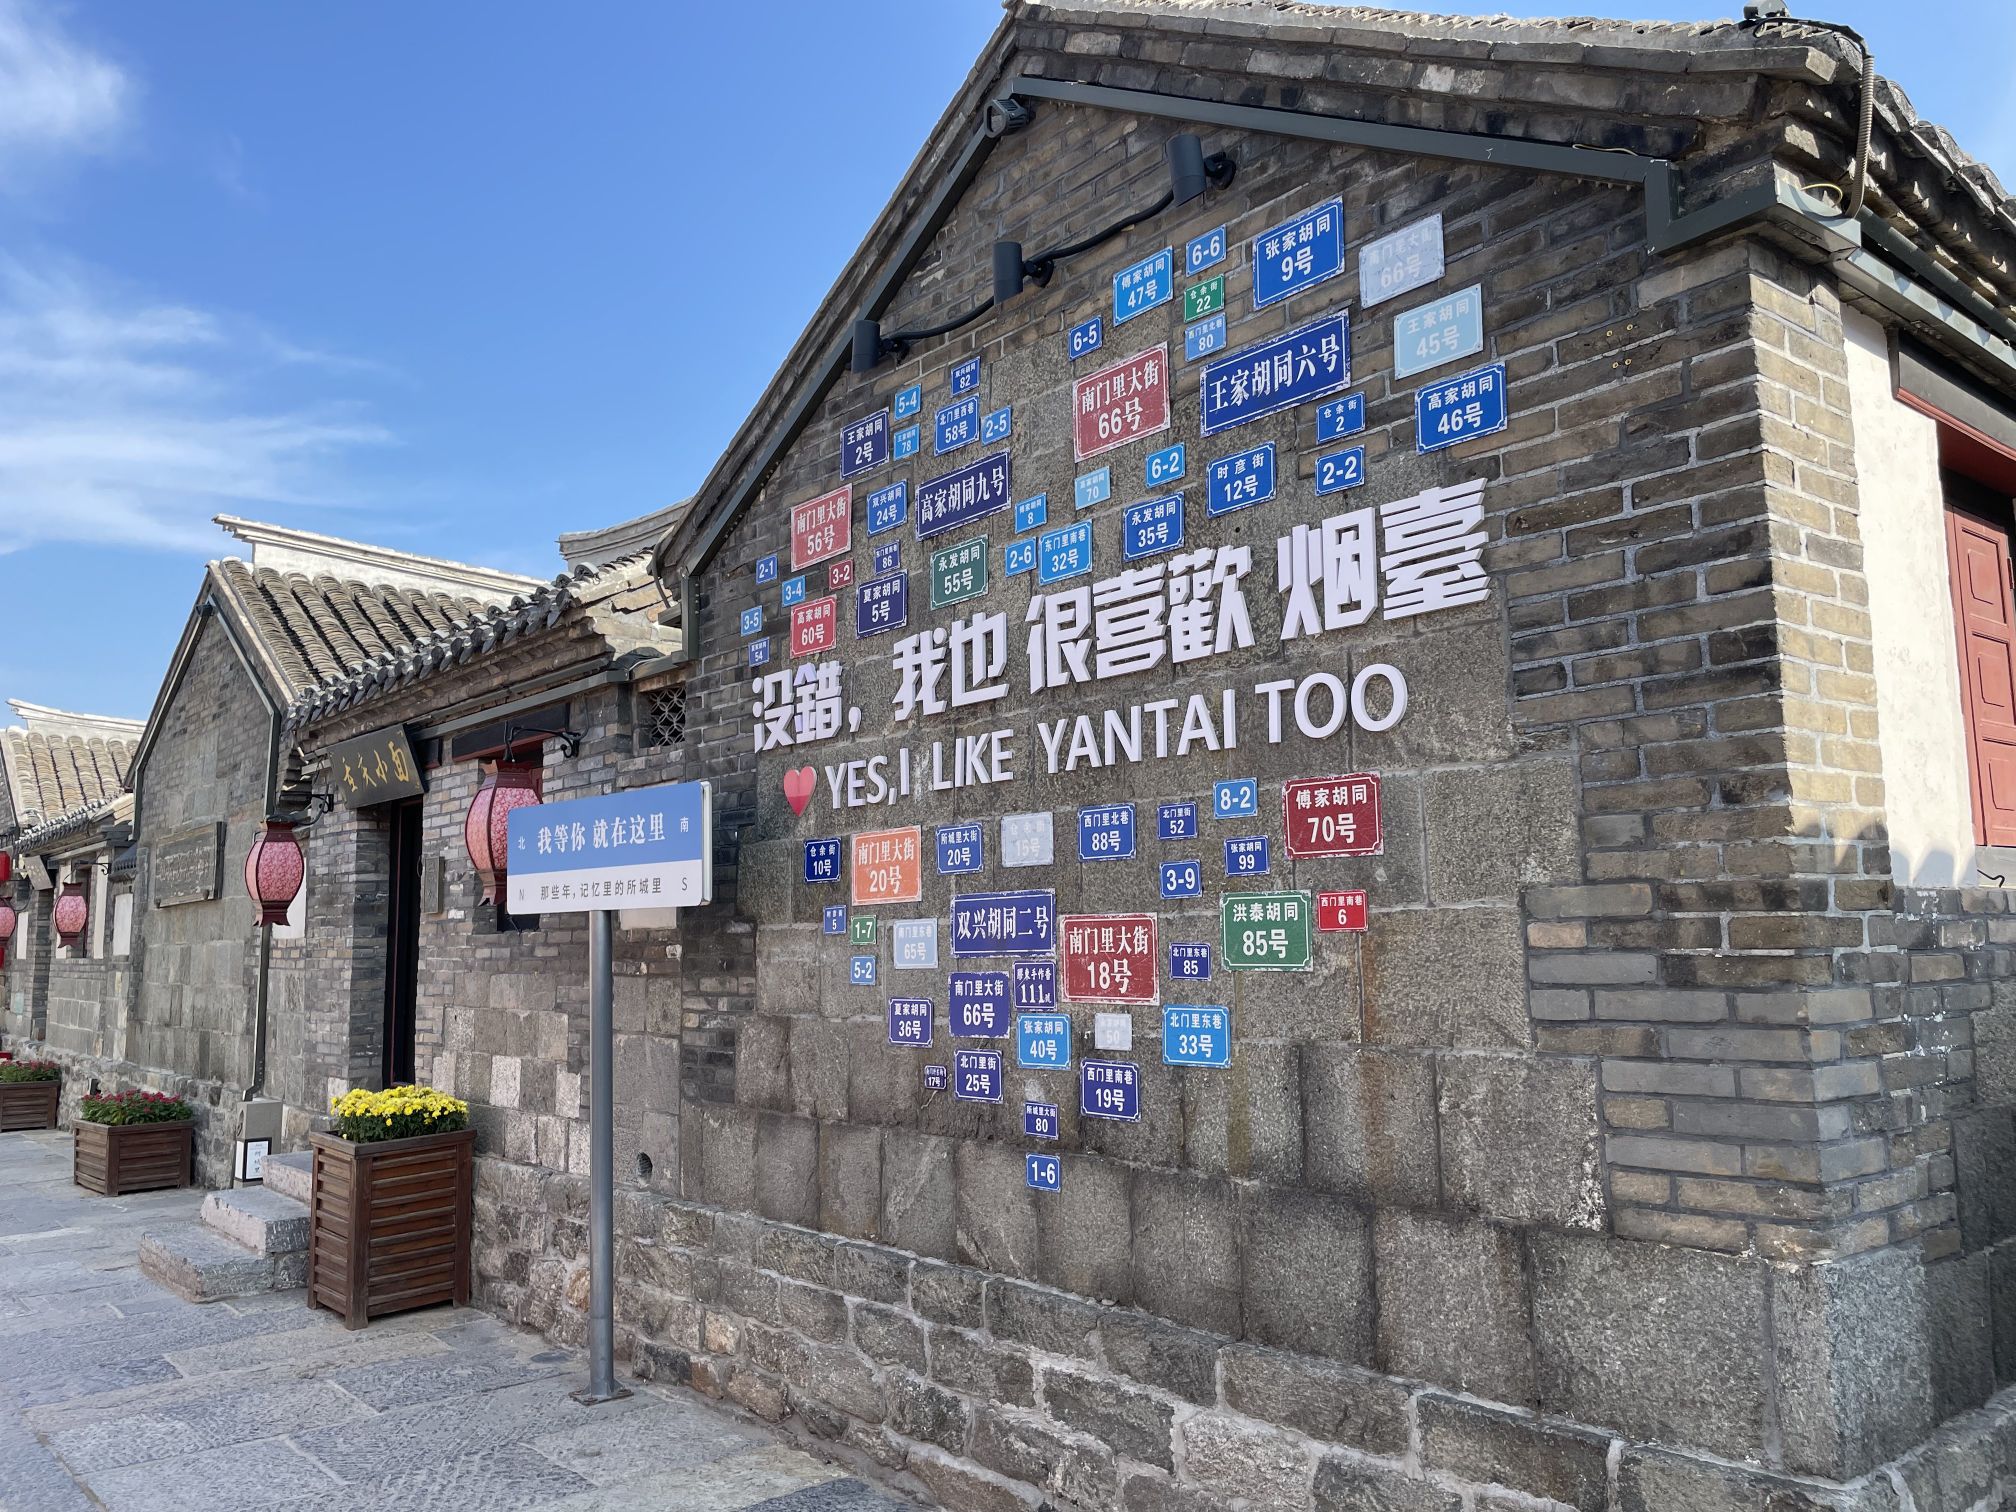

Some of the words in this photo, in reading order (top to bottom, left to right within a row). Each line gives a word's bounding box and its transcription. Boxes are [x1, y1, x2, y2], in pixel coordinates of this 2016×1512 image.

[1265, 213, 1330, 260] 张家胡同
[1192, 236, 1220, 266] 6-6
[1122, 258, 1165, 290] 傅家胡同
[1281, 246, 1313, 282] 9号
[1381, 254, 1422, 288] 66号
[1128, 280, 1158, 308] 47号
[1197, 295, 1211, 312] 22
[1407, 299, 1469, 335] 王家胡同
[1074, 324, 1097, 351] 6-5
[1199, 335, 1213, 351] 80
[1416, 326, 1460, 358] 45号
[959, 375, 970, 388] 82
[1209, 334, 1339, 412] 王家胡同六号
[1081, 359, 1158, 414] 南门里大街
[1428, 375, 1493, 411] 高家胡同
[898, 392, 917, 413] 5-4
[1324, 400, 1357, 419] 仓余街
[940, 406, 974, 425] 北门里西巷
[986, 414, 1007, 438] 2-5
[1098, 397, 1142, 439] 66号
[1335, 416, 1344, 432] 2
[1438, 402, 1483, 434] 46号
[847, 418, 882, 445] 王家胡同
[945, 421, 968, 444] 58号
[855, 441, 873, 465] 2号
[902, 440, 912, 453] 78
[1152, 452, 1179, 479] 6-2
[1217, 453, 1264, 479] 时彦街
[1323, 456, 1357, 485] 2-2
[921, 465, 1004, 524] 高家胡同九号
[1086, 487, 1099, 502] 70
[1224, 474, 1258, 502] 12号
[797, 497, 846, 535] 南门里大街
[877, 507, 897, 526] 24号
[1027, 512, 1033, 525] 8
[1131, 502, 1176, 526] 永发胡同
[807, 524, 835, 556] 56号
[1045, 528, 1086, 552] 东门里南巷
[1138, 522, 1168, 547] 35号
[882, 555, 892, 569] 86
[938, 545, 980, 572] 永发胡同
[1010, 545, 1032, 569] 2-6
[1052, 548, 1078, 572] 32号
[759, 560, 774, 579] 2-1
[832, 565, 850, 584] 3-2
[785, 582, 802, 601] 3-4
[863, 579, 900, 603] 夏家胡同
[944, 568, 973, 595] 55号
[744, 611, 759, 631] 3-5
[797, 604, 830, 625] 高家胡同
[871, 600, 890, 623] 5号
[801, 623, 825, 646] 60号
[755, 650, 763, 661] 54
[892, 610, 1010, 722] 我也
[933, 728, 1014, 791] LIKE
[1037, 688, 1237, 775] YANTAI
[1254, 663, 1409, 745] TOO
[1221, 787, 1250, 810] 8-2
[1296, 784, 1367, 810] 傅家胡同
[1084, 812, 1129, 828] 西门里北巷
[1163, 807, 1191, 818] 北门里街
[518, 836, 526, 850] 北
[538, 822, 586, 854] 我等你
[593, 812, 666, 849] 就在这里
[680, 817, 689, 833] 南
[941, 830, 977, 844] 所城里大街
[1170, 820, 1184, 834] 52
[1308, 813, 1357, 844] 70号
[858, 838, 914, 866] 南门里大街
[1092, 831, 1121, 851] 88号
[1231, 842, 1261, 854] 张家胡同
[813, 859, 831, 876] 10号
[948, 848, 971, 866] 20号
[1238, 854, 1255, 870] 99
[520, 890, 525, 900] N
[682, 877, 688, 891] S
[870, 865, 902, 894] 20号
[1166, 868, 1195, 891] 3-9
[1233, 902, 1299, 922] 洪泰胡同
[1321, 896, 1363, 907] 西门里南巷
[832, 919, 837, 930] 5
[957, 906, 1048, 940] 双兴胡同二号
[1338, 909, 1347, 925] 6
[855, 922, 872, 938] 1-7
[1068, 925, 1148, 955] 南门里大街
[904, 942, 927, 961] 65号
[1173, 948, 1207, 958] 北门里东巷
[1243, 929, 1288, 959] 85号
[854, 962, 872, 978] 5-2
[1087, 958, 1132, 994] 18号
[1183, 960, 1198, 975] 85
[954, 980, 1003, 997] 南门里大街
[894, 1003, 927, 1016] 夏家胡同
[963, 1003, 995, 1029] 66号
[1170, 1013, 1222, 1029] 北门里东巷
[899, 1021, 921, 1039] 36号
[1024, 1021, 1063, 1035] 张家胡同
[1030, 1040, 1057, 1061] 40号
[1179, 1035, 1213, 1058] 33号
[961, 1055, 996, 1070] 北门里街
[966, 1074, 990, 1094] 25号
[1087, 1067, 1133, 1085] 西门里南巷
[1095, 1088, 1125, 1112] 19号
[1035, 1118, 1048, 1132] 80
[1032, 1161, 1055, 1184] 1-6
